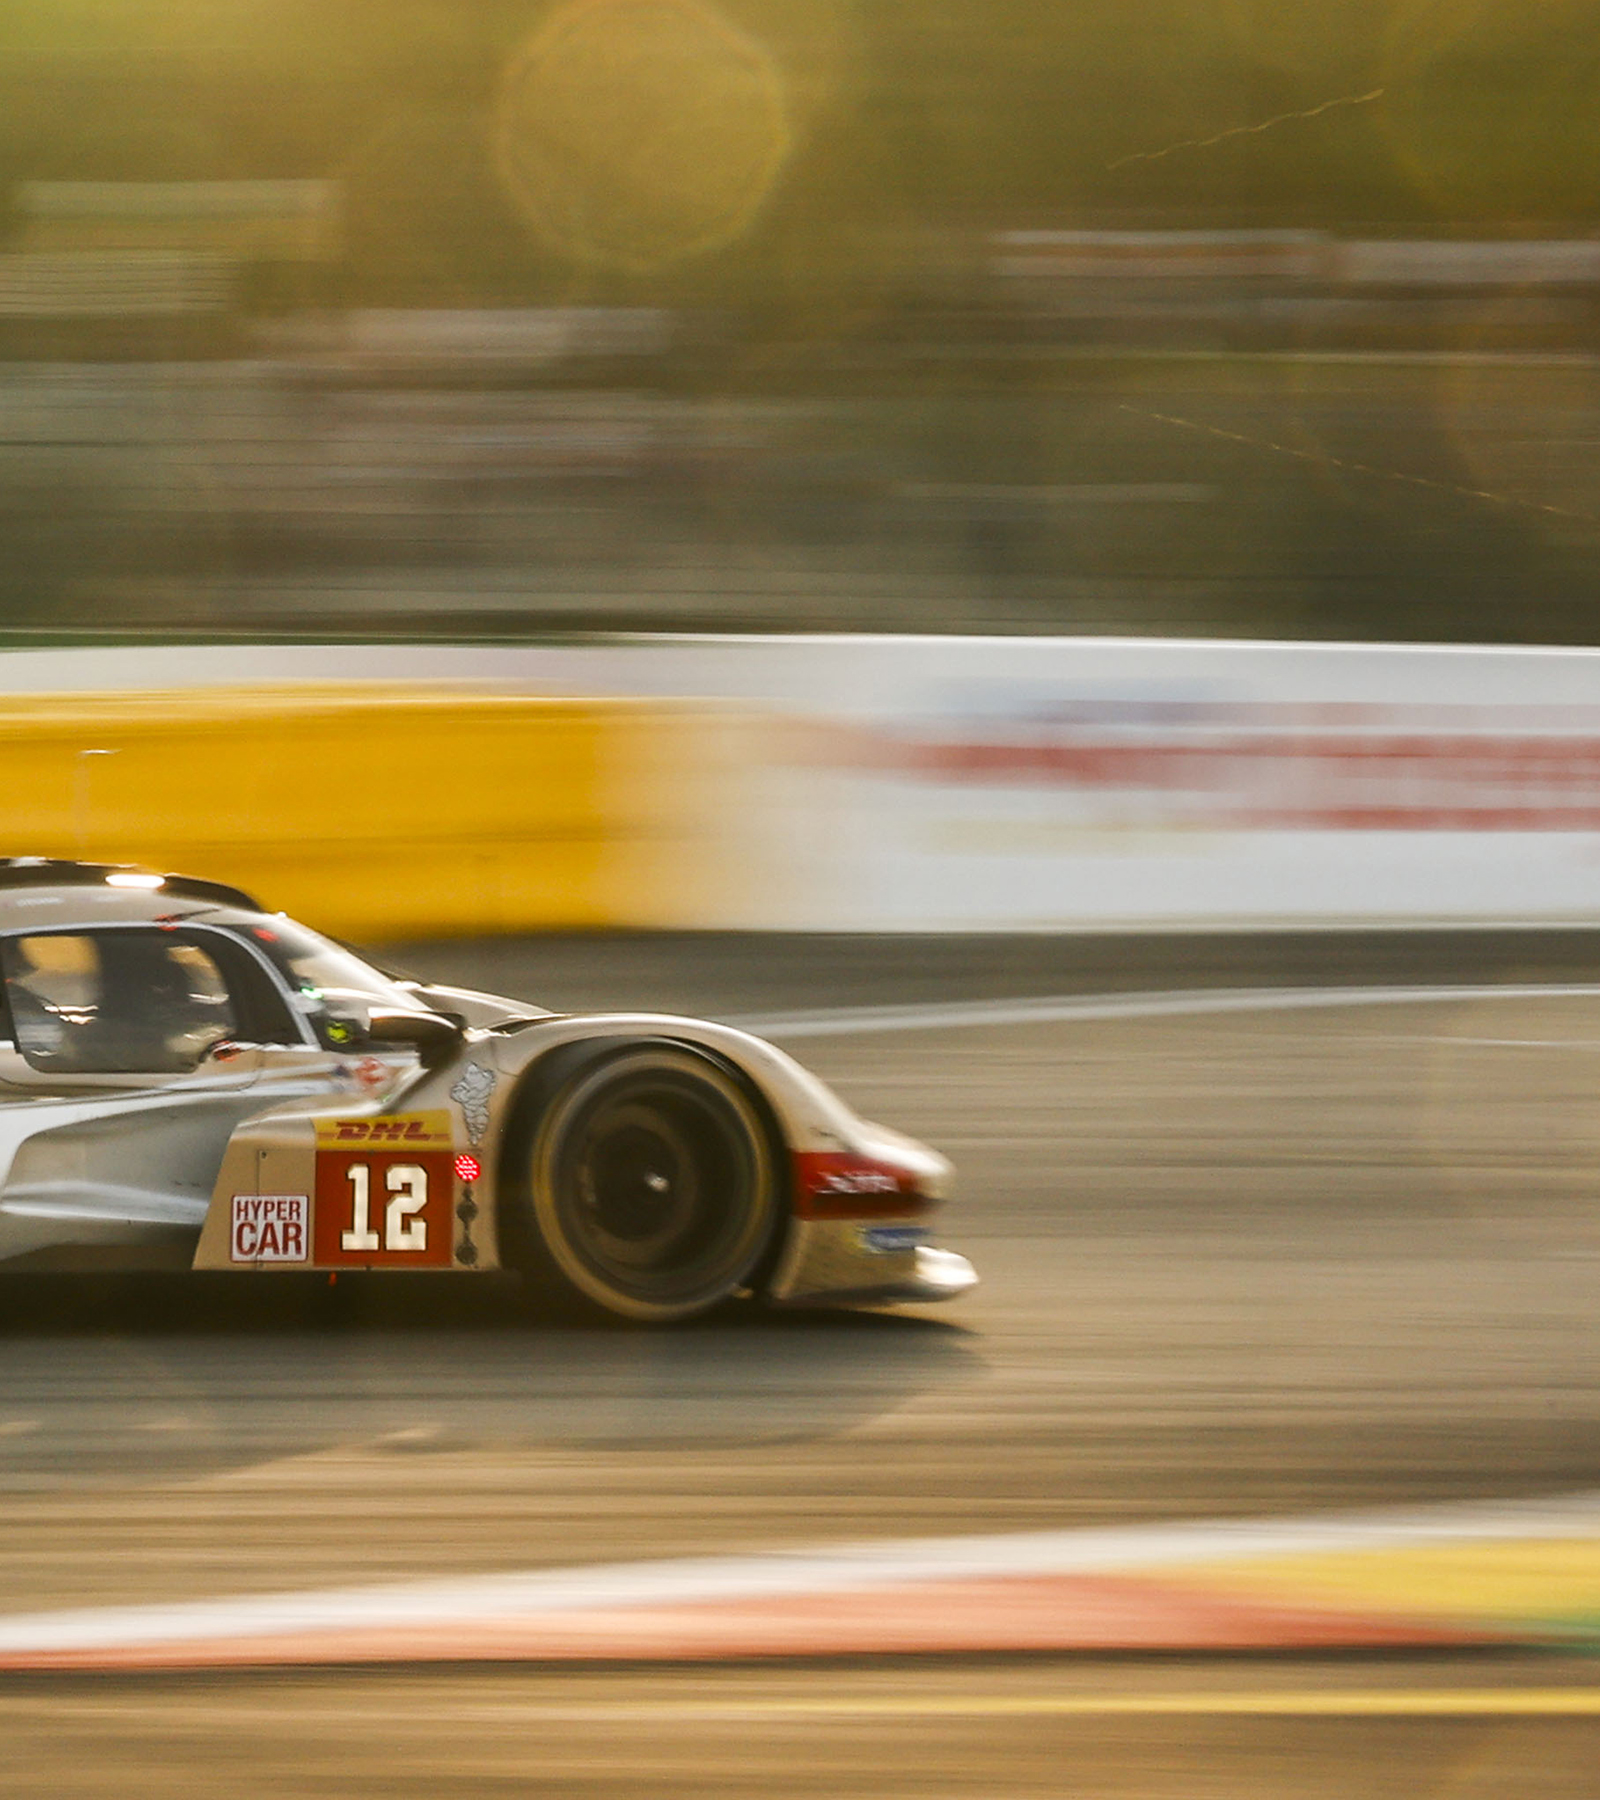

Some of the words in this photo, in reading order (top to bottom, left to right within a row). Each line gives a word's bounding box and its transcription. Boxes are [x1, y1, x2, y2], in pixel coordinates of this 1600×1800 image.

[335, 1121, 432, 1142] DHL
[236, 1200, 301, 1221] HYPER
[342, 1164, 428, 1251] 12
[236, 1222, 302, 1256] CAR
